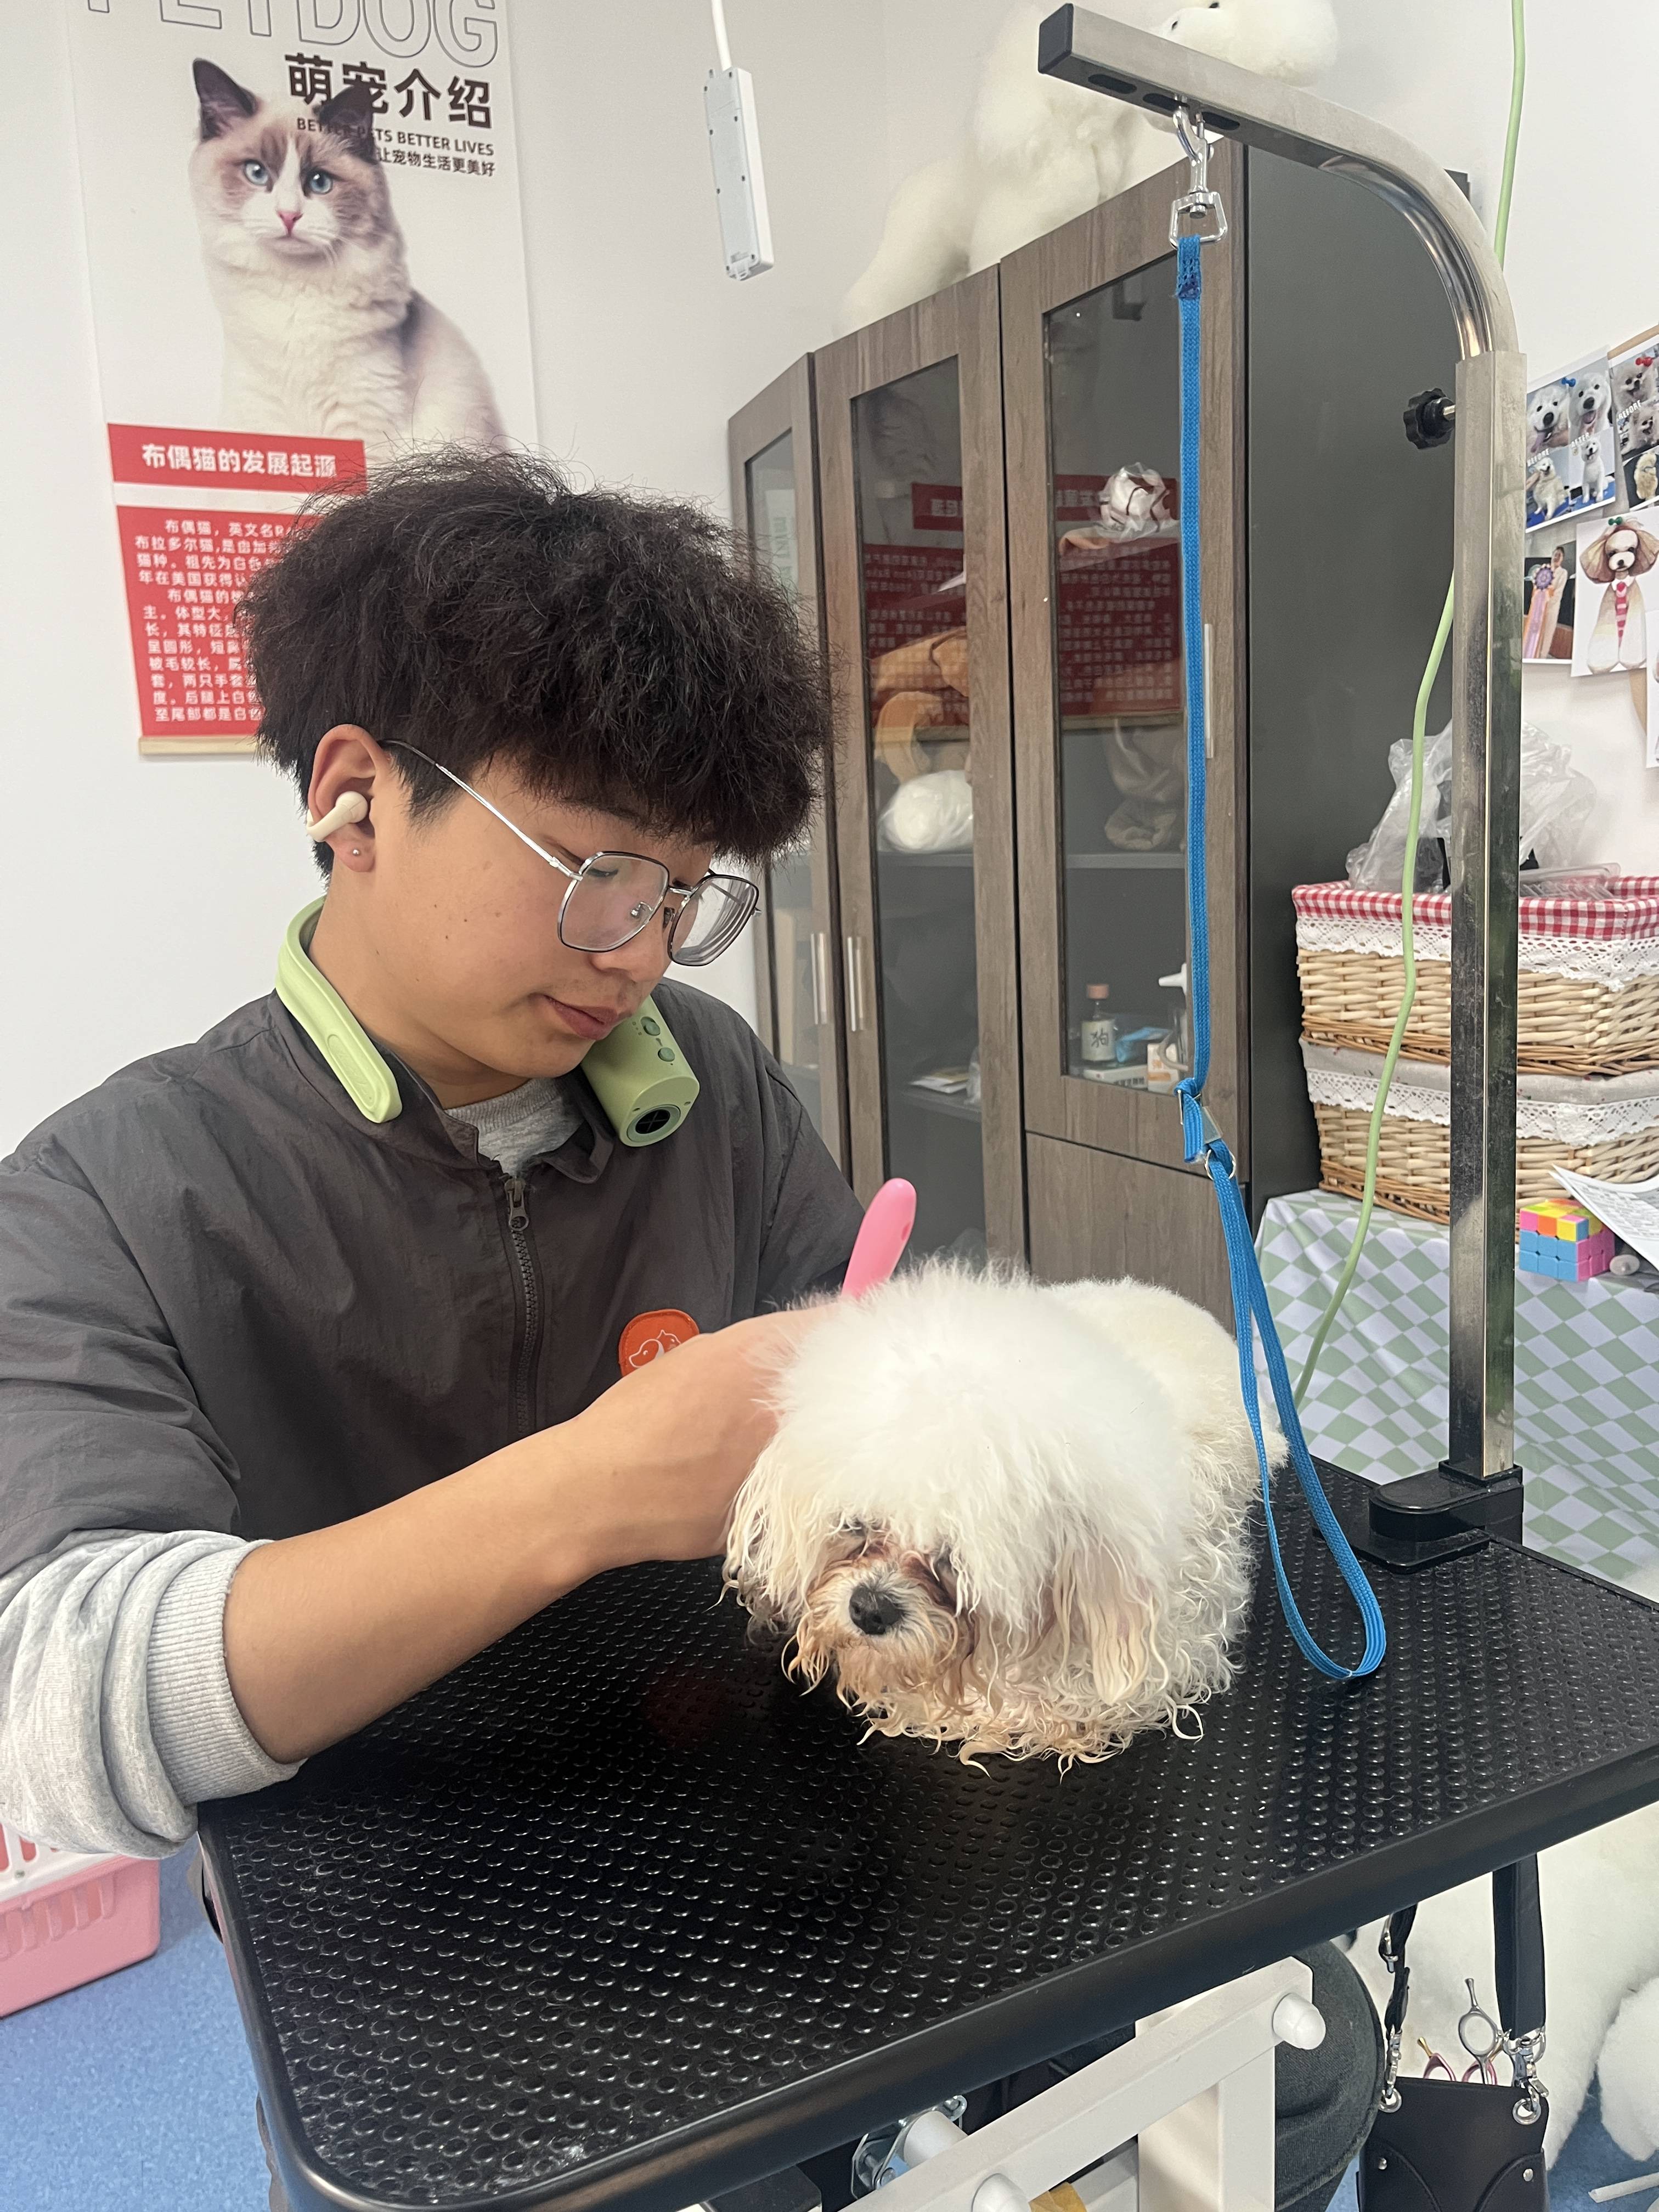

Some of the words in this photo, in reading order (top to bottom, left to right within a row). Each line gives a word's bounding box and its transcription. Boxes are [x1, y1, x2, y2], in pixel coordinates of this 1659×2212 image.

[87, 0, 498, 67] DOG
[285, 52, 492, 128] 萌宠介绍
[398, 133, 450, 150] BETTER
[455, 138, 494, 156] LIVES
[377, 146, 495, 176] 让宠物生活更美好
[142, 443, 336, 478] 布偶猫的发展起源
[166, 519, 292, 538] 布偶猫，英文名R
[1091, 1028, 1109, 1048] 狗
